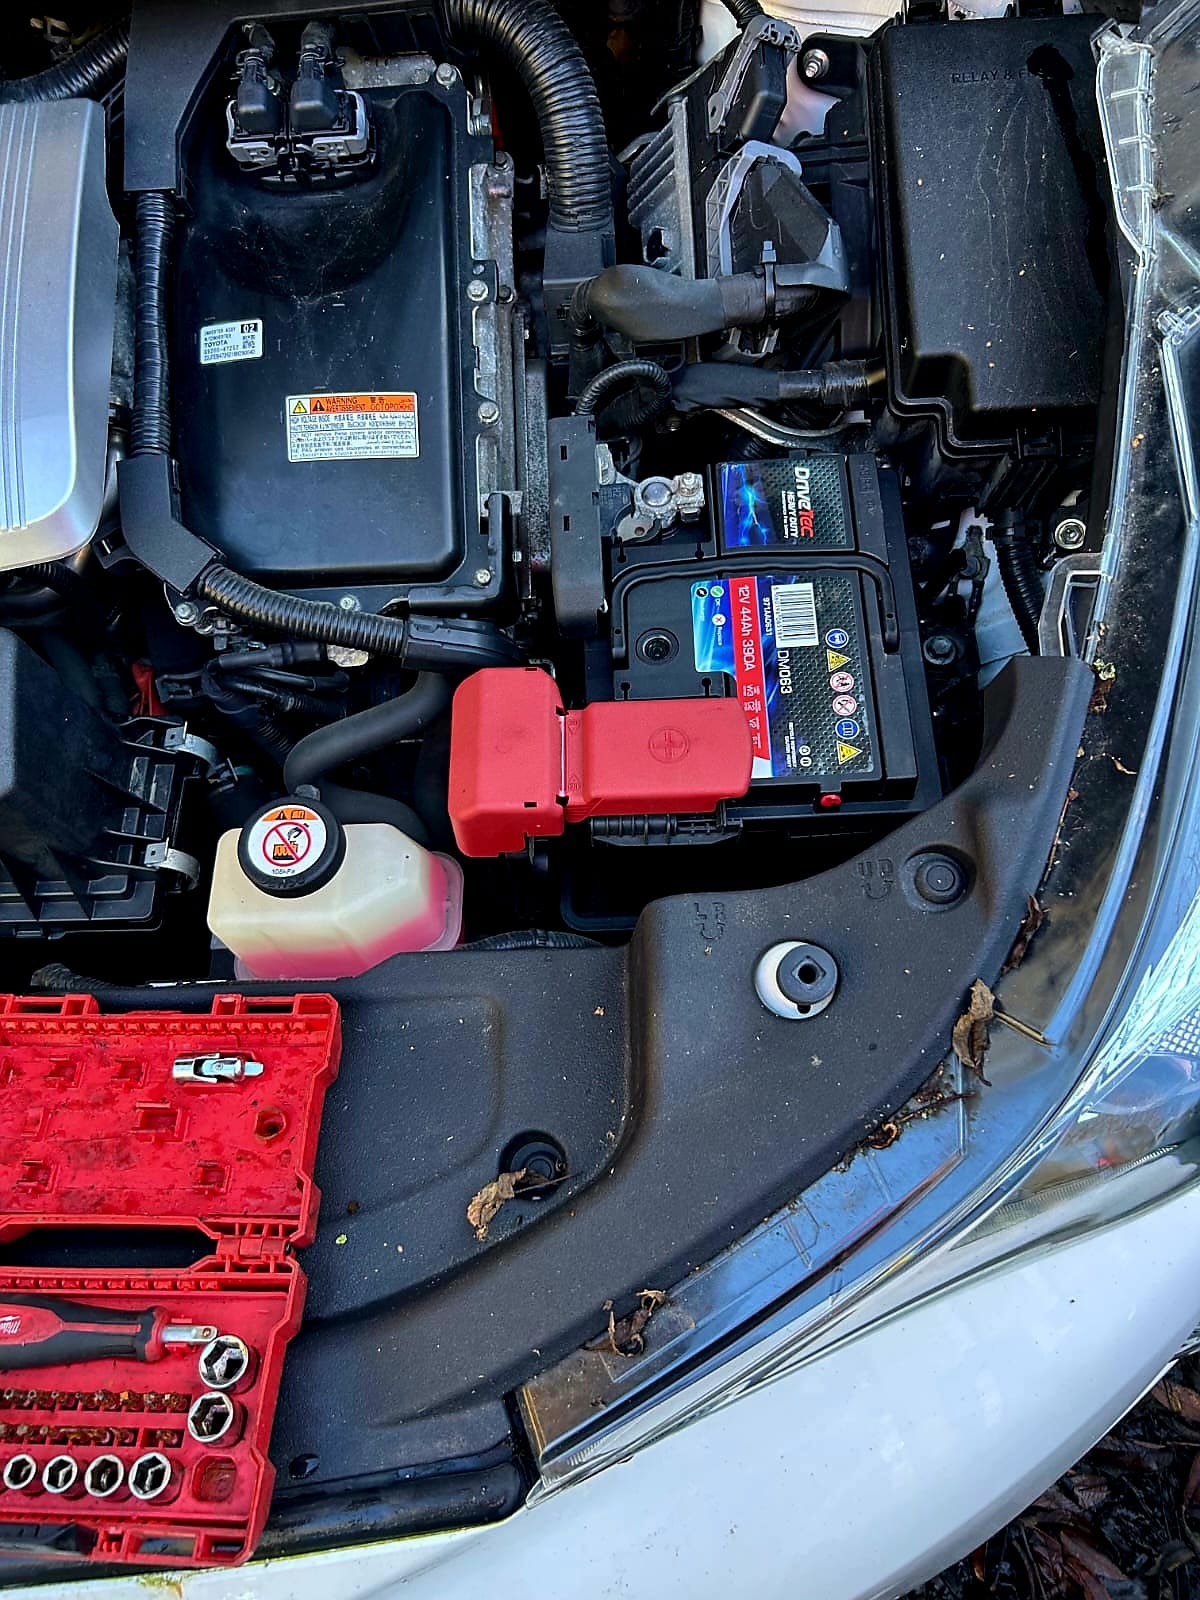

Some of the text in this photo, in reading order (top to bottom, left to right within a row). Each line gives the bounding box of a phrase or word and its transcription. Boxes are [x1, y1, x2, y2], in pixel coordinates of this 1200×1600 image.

[952, 71, 998, 83] RELAY
[243, 324, 255, 333] 02
[204, 340, 228, 348] TOYOTA
[326, 396, 357, 406] WARNING
[787, 490, 799, 538] HEAVY DUTY
[794, 466, 816, 538] DriveTec
[738, 584, 750, 604] 12V
[740, 606, 753, 637] 44Ah
[742, 639, 756, 672] 390A
[777, 650, 793, 694] DM063
